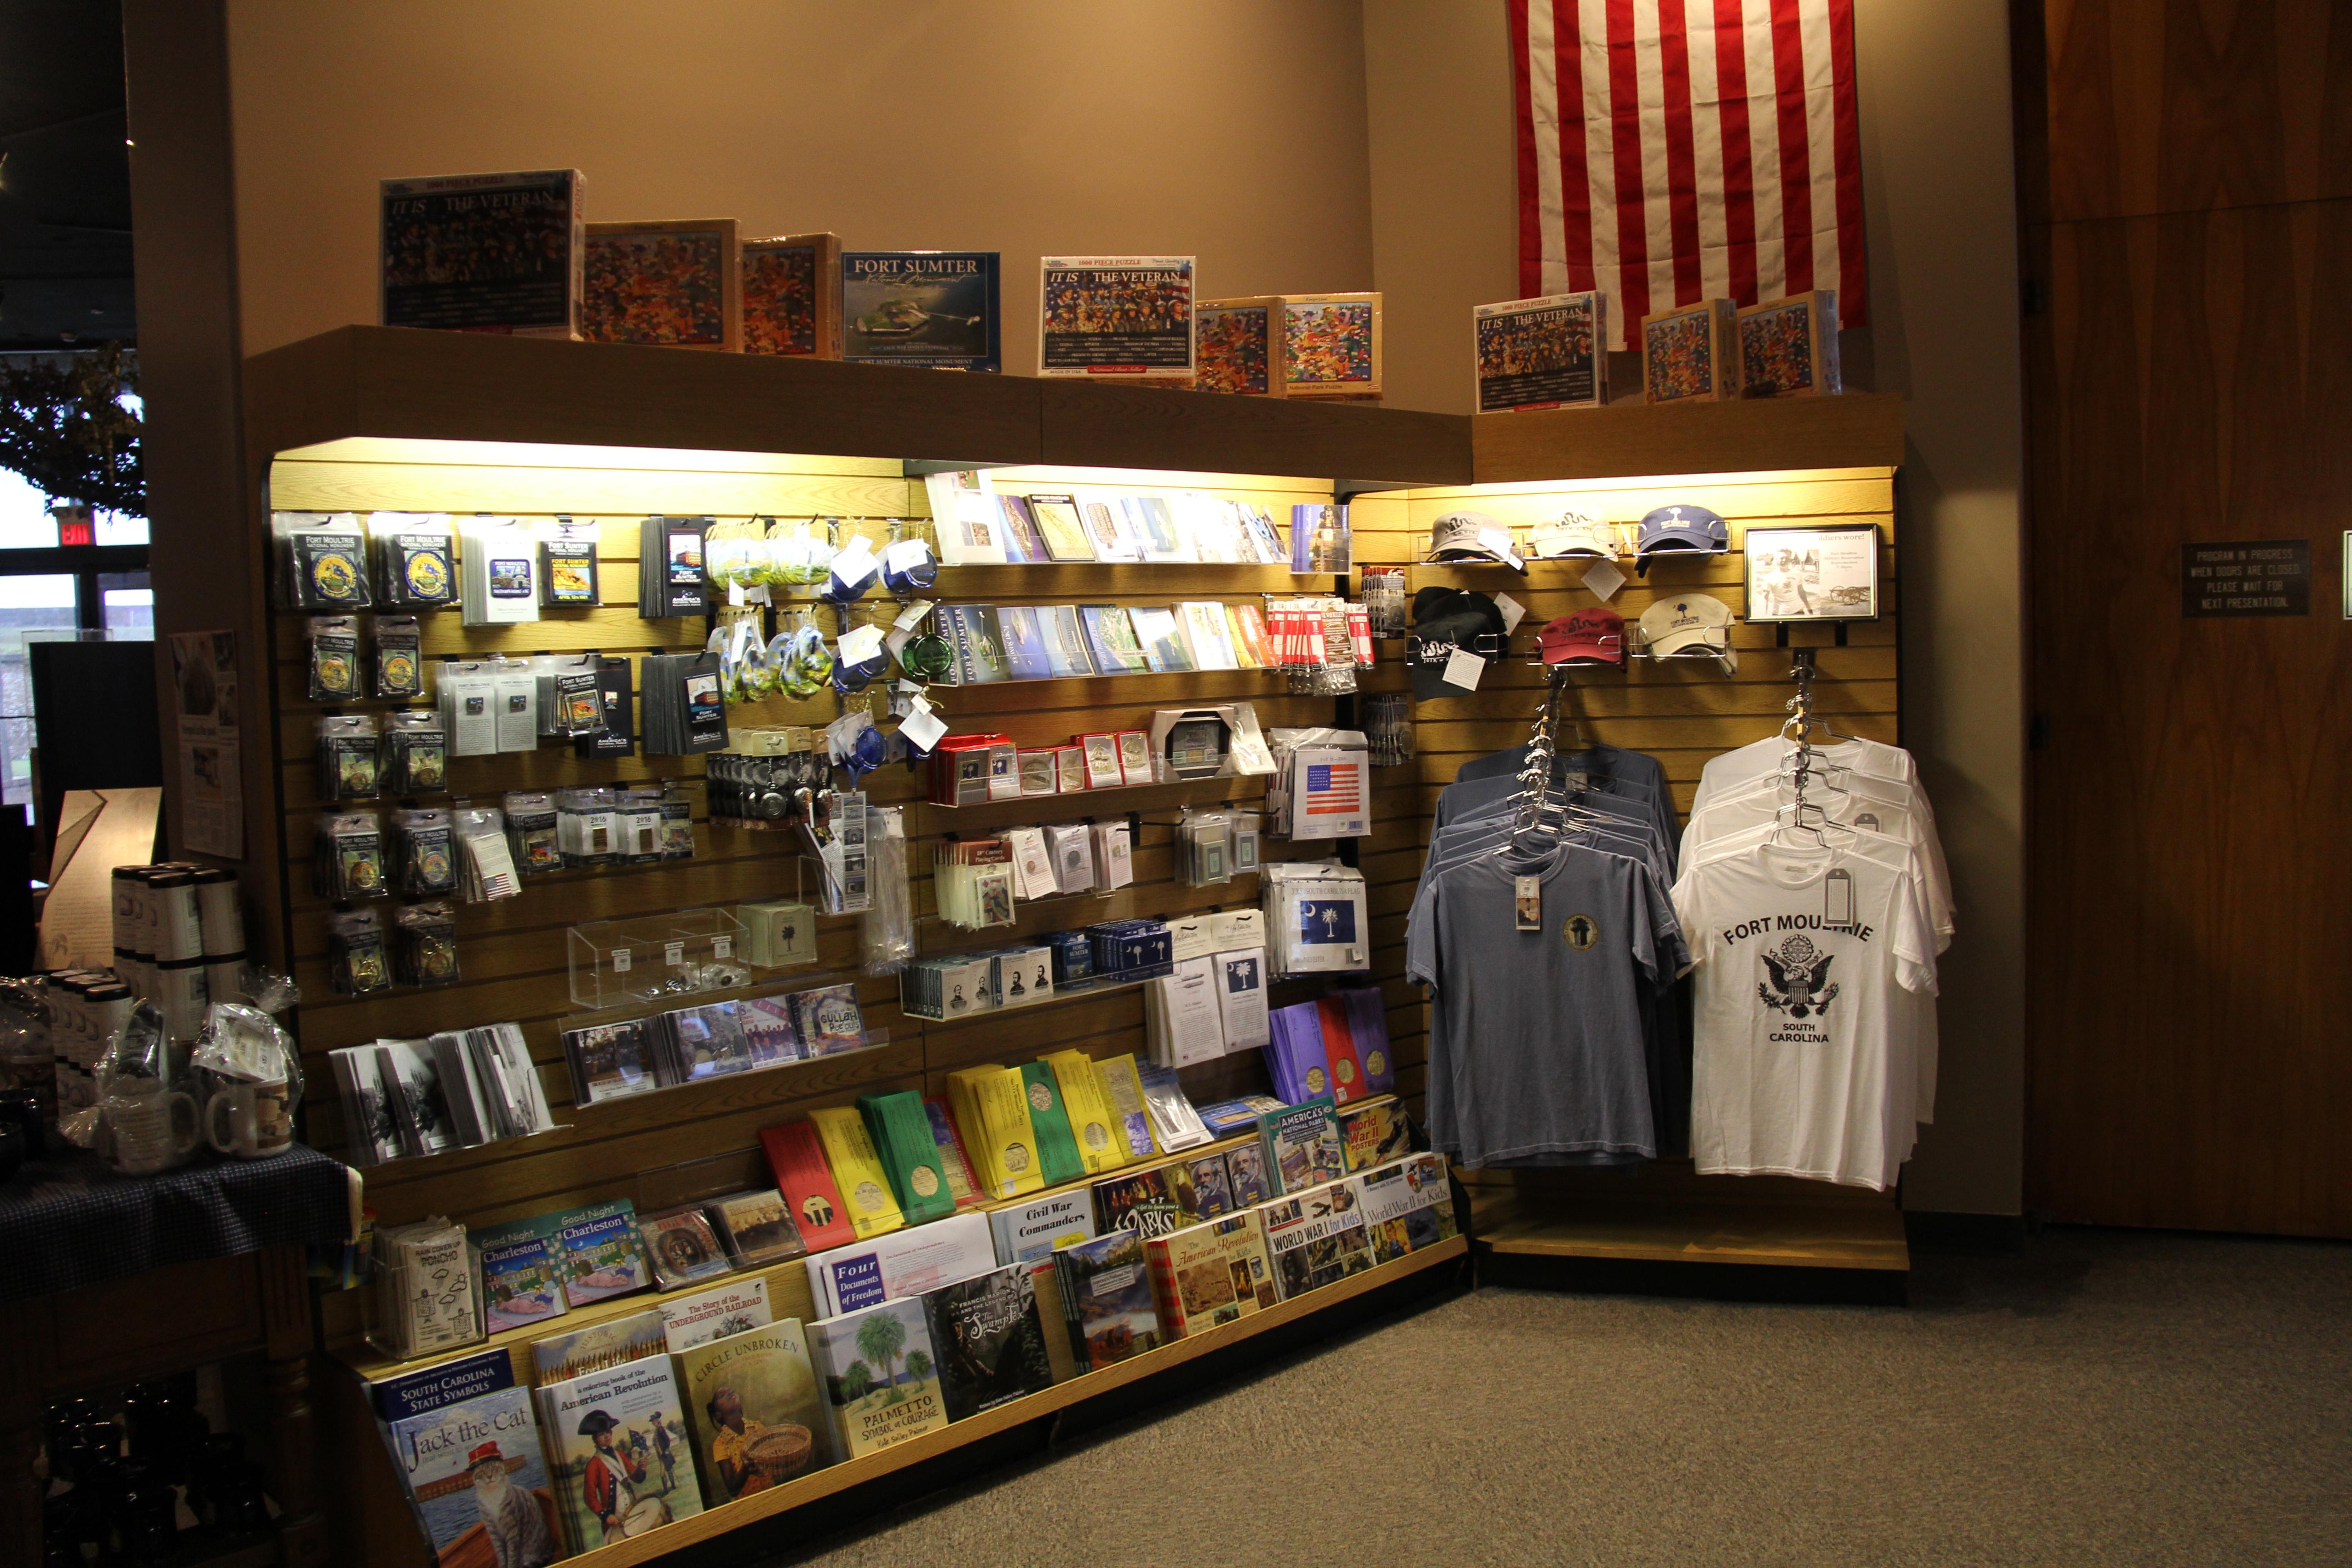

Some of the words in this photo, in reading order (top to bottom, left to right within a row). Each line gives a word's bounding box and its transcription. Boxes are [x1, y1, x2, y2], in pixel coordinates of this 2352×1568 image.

[392, 201, 407, 215] IT
[411, 199, 427, 213] IS
[444, 196, 477, 212] THE
[479, 190, 554, 208] VETERAN
[854, 260, 901, 273] FORT
[905, 259, 978, 273] SUMTER
[1050, 272, 1064, 283] IT
[1066, 272, 1079, 283] IS
[1093, 272, 1119, 282] THE
[1531, 299, 1551, 308] PUZZLE
[1481, 320, 1493, 330] IT
[1494, 318, 1503, 328] IS
[1513, 314, 1534, 326] THE
[62, 523, 89, 545] EXIT
[323, 536, 354, 544] MOULTRIE
[400, 535, 415, 544] FORT
[416, 535, 446, 544] MOULTRIE
[2197, 550, 2234, 562] PROGRAM
[2238, 550, 2247, 560] IN
[2251, 549, 2293, 560] PROGRESS
[2190, 567, 2212, 578] WHEN
[2216, 565, 2243, 577] DOORS
[2247, 564, 2262, 576] ARE
[2206, 582, 2238, 593] PLEASE
[2243, 581, 2261, 592] WAIT
[2267, 580, 2283, 590] FOR
[2201, 598, 2222, 609] NEXT
[955, 607, 969, 652] SUMTER
[1002, 626, 1011, 640] FORT
[1008, 641, 1019, 664] SUMTER
[964, 653, 975, 681] FORT
[575, 675, 595, 683] SUMTER
[1723, 916, 1771, 946] FORT
[1777, 914, 1874, 943] MOURIE
[1069, 948, 1089, 957] SUMTER
[1783, 1023, 1816, 1031] SOUTH
[1769, 1033, 1829, 1043] CAROLINA
[1281, 1107, 1323, 1128] AMERICA'S
[1282, 1122, 1308, 1134] NATIONAL
[1308, 1118, 1325, 1127] PARKS
[1347, 1115, 1377, 1133] World
[1350, 1130, 1370, 1144] War
[1372, 1126, 1379, 1138] II
[1351, 1137, 1380, 1152] POSTERS
[1026, 1205, 1049, 1221] Civil
[1051, 1201, 1073, 1214] War
[1367, 1202, 1392, 1222] World
[1392, 1199, 1409, 1214] War
[1408, 1196, 1416, 1209] II
[1416, 1195, 1427, 1205] for
[1427, 1186, 1448, 1201] Kids
[562, 1213, 585, 1226] Good
[588, 1205, 615, 1219] Night
[1019, 1212, 1086, 1238] Commanders
[482, 1236, 505, 1249] Good
[508, 1229, 535, 1242] Night
[563, 1217, 622, 1241] Charleston
[1273, 1230, 1304, 1252] WORLD
[1304, 1223, 1324, 1242] WAR
[1328, 1219, 1341, 1234] for
[1340, 1212, 1360, 1230] Kids
[431, 1243, 453, 1253] COVER
[483, 1243, 542, 1263] Charleston
[885, 1250, 911, 1260] Declaration
[917, 1240, 945, 1250] Independence
[1176, 1238, 1216, 1267] American
[1218, 1231, 1259, 1252] Revolution
[1188, 1241, 1199, 1250] The
[1236, 1248, 1252, 1258] Kids
[421, 1250, 458, 1267] PONCHO
[837, 1260, 877, 1280] Four
[840, 1274, 879, 1292] Documents
[689, 1305, 702, 1314] The
[702, 1300, 720, 1311] Story
[721, 1296, 728, 1305] of
[729, 1294, 740, 1303] the
[842, 1294, 851, 1305] of
[851, 1287, 882, 1303] Freedom
[959, 1295, 986, 1308] FRANCIS
[987, 1288, 1011, 1299] MARION
[985, 1297, 1006, 1307] LEGEND
[669, 1307, 724, 1329] UNDERGROUND
[725, 1296, 762, 1313] RAILROAD
[963, 1312, 1008, 1339] Swamp
[581, 1330, 617, 1350] HISTORIC
[696, 1350, 733, 1382] CIRCLE
[734, 1338, 799, 1356] UNBROKEN
[401, 1382, 438, 1402] SOUTH
[441, 1367, 495, 1390] CAROLINA
[561, 1390, 612, 1411] American
[613, 1374, 668, 1396] Revolution
[582, 1380, 610, 1392] coloring
[610, 1374, 626, 1384] book
[410, 1395, 442, 1413] STATE
[444, 1380, 490, 1401] SYMBOLS
[862, 1421, 893, 1441] SYMBOL
[901, 1406, 939, 1426] COURAGE
[407, 1428, 456, 1473] Jack
[458, 1421, 490, 1443] the
[494, 1407, 528, 1431] Cat
